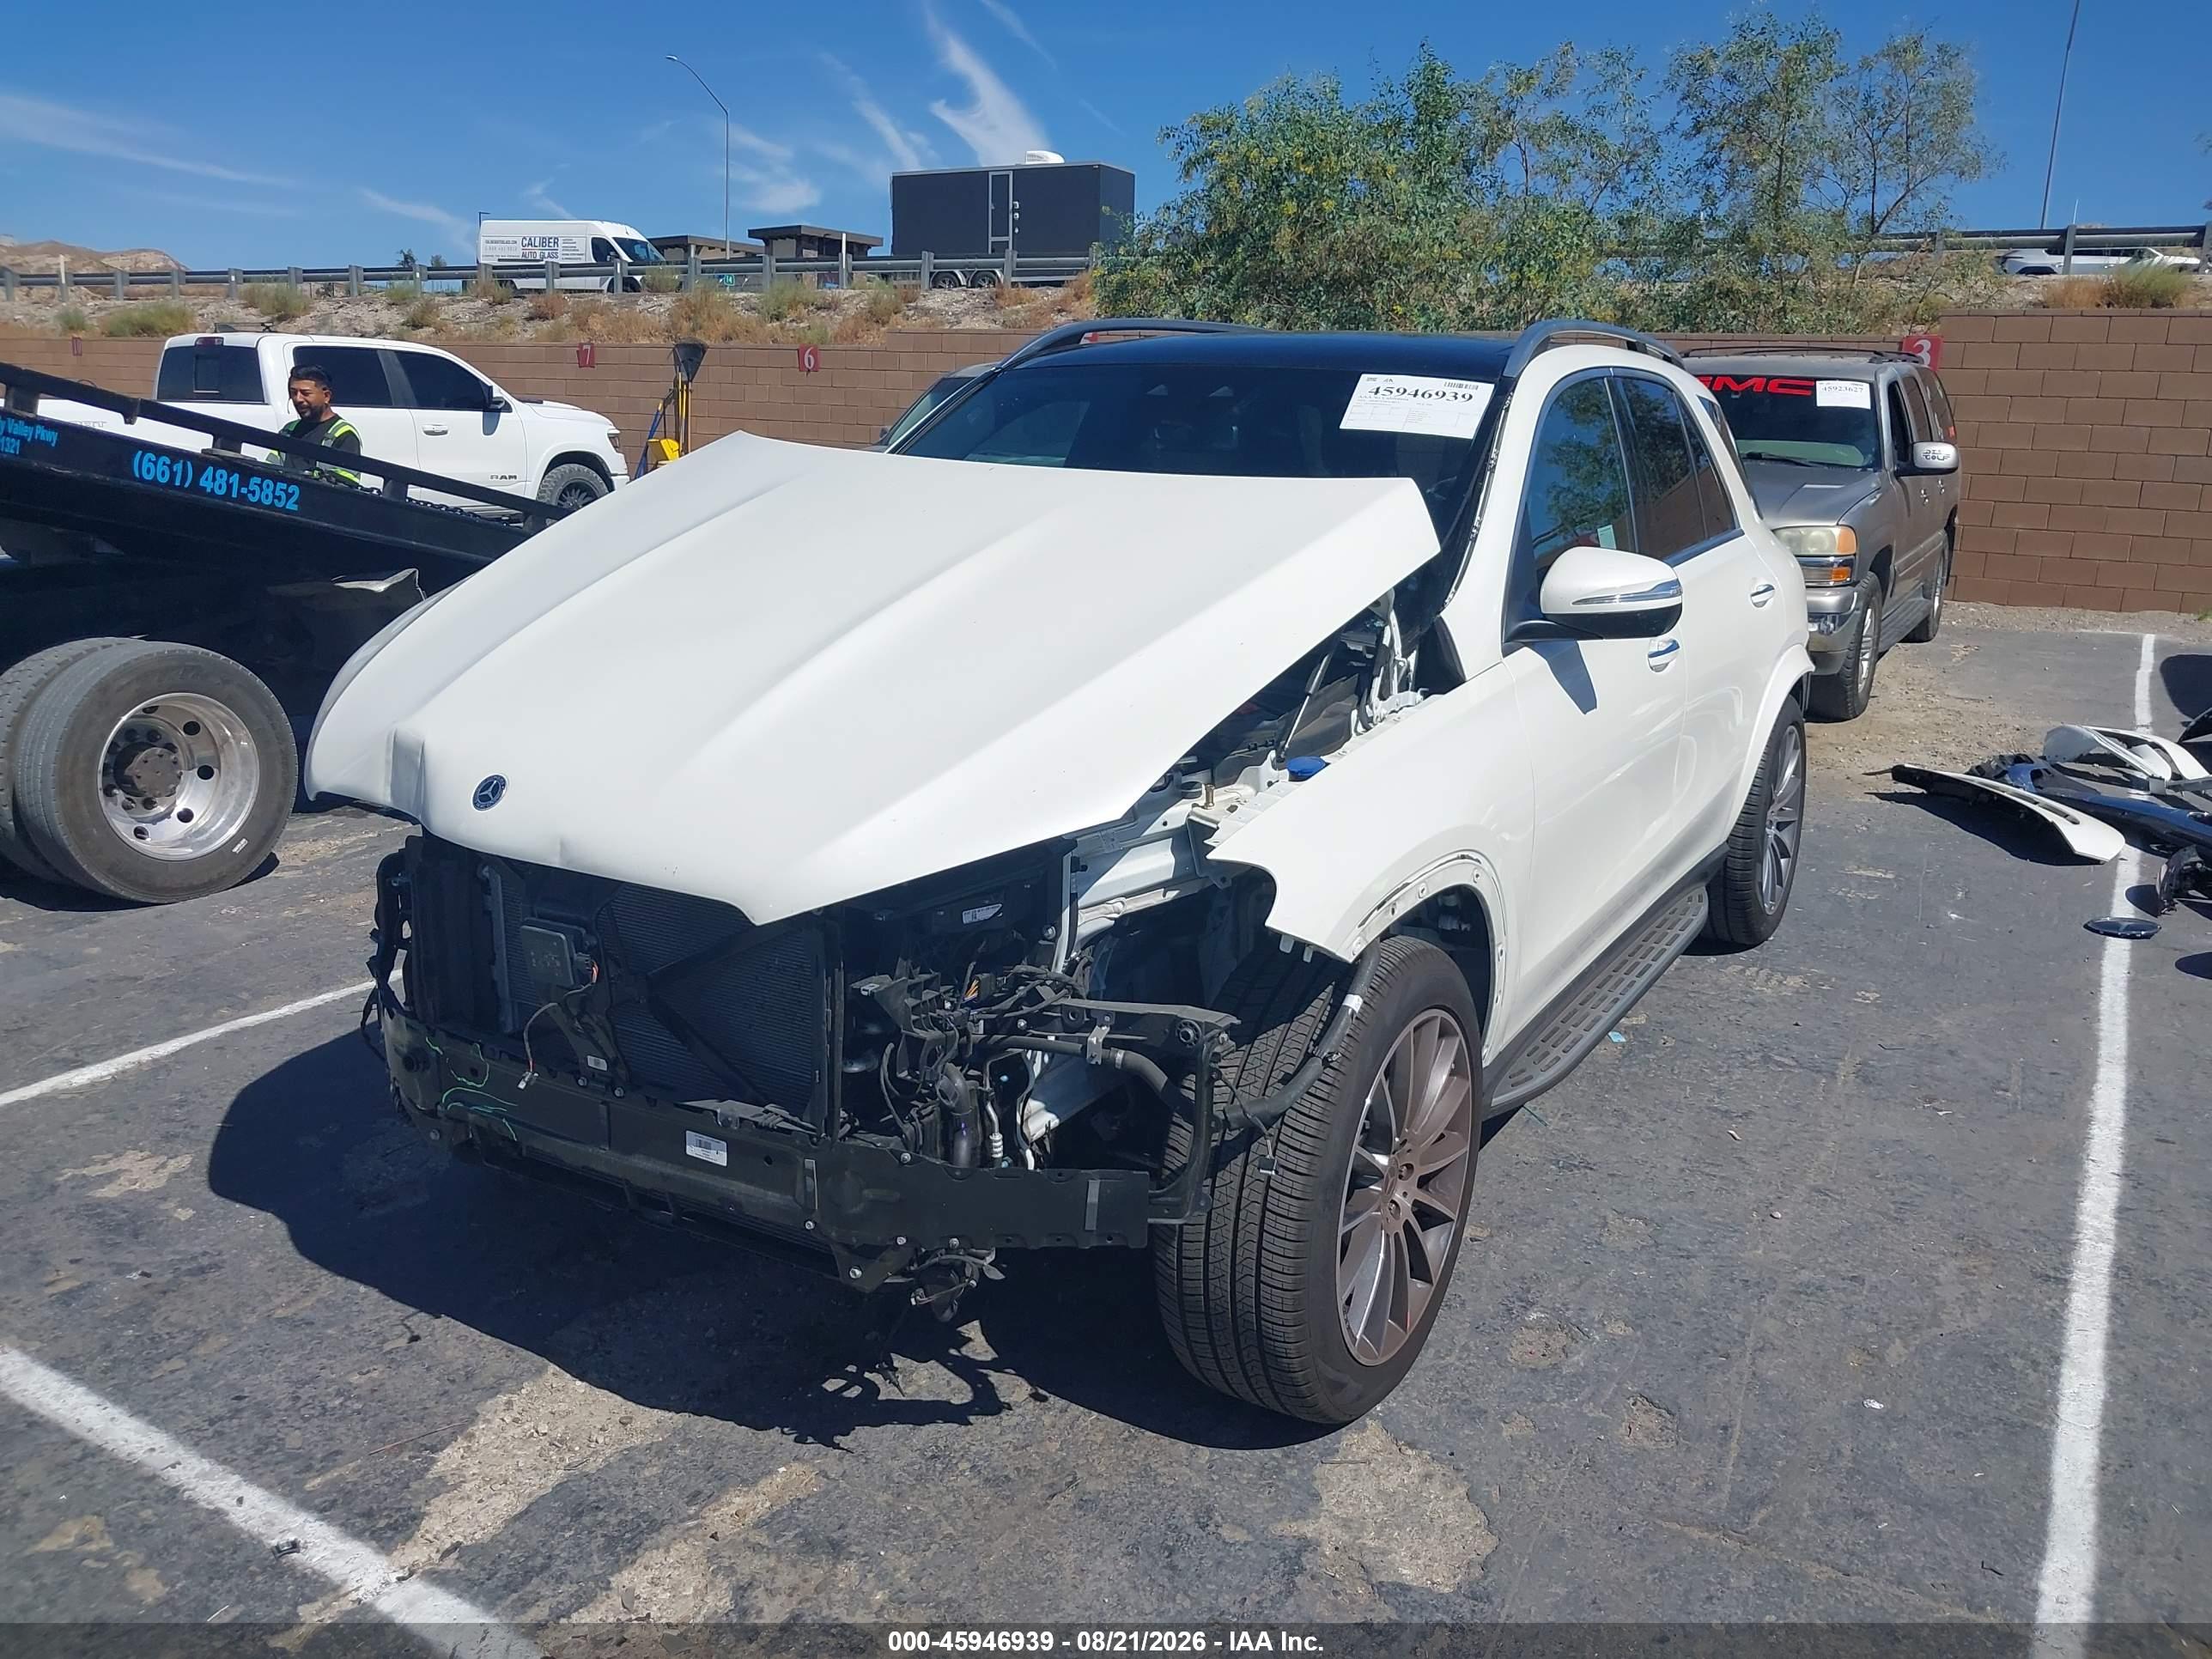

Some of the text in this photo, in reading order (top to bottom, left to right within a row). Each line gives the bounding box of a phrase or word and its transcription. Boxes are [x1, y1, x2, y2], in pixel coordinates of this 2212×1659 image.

[520, 236, 559, 248] CALIBER
[521, 251, 538, 259] AUTO
[539, 251, 559, 259] GLASS
[583, 344, 592, 365] 7
[805, 346, 815, 369] 6
[1913, 339, 1931, 366] 3
[1368, 386, 1474, 404] 45946939
[7, 417, 34, 441] Valley
[34, 424, 58, 447] Pkwy
[0, 435, 21, 455] 1321
[133, 451, 301, 511] (661) 481-5852
